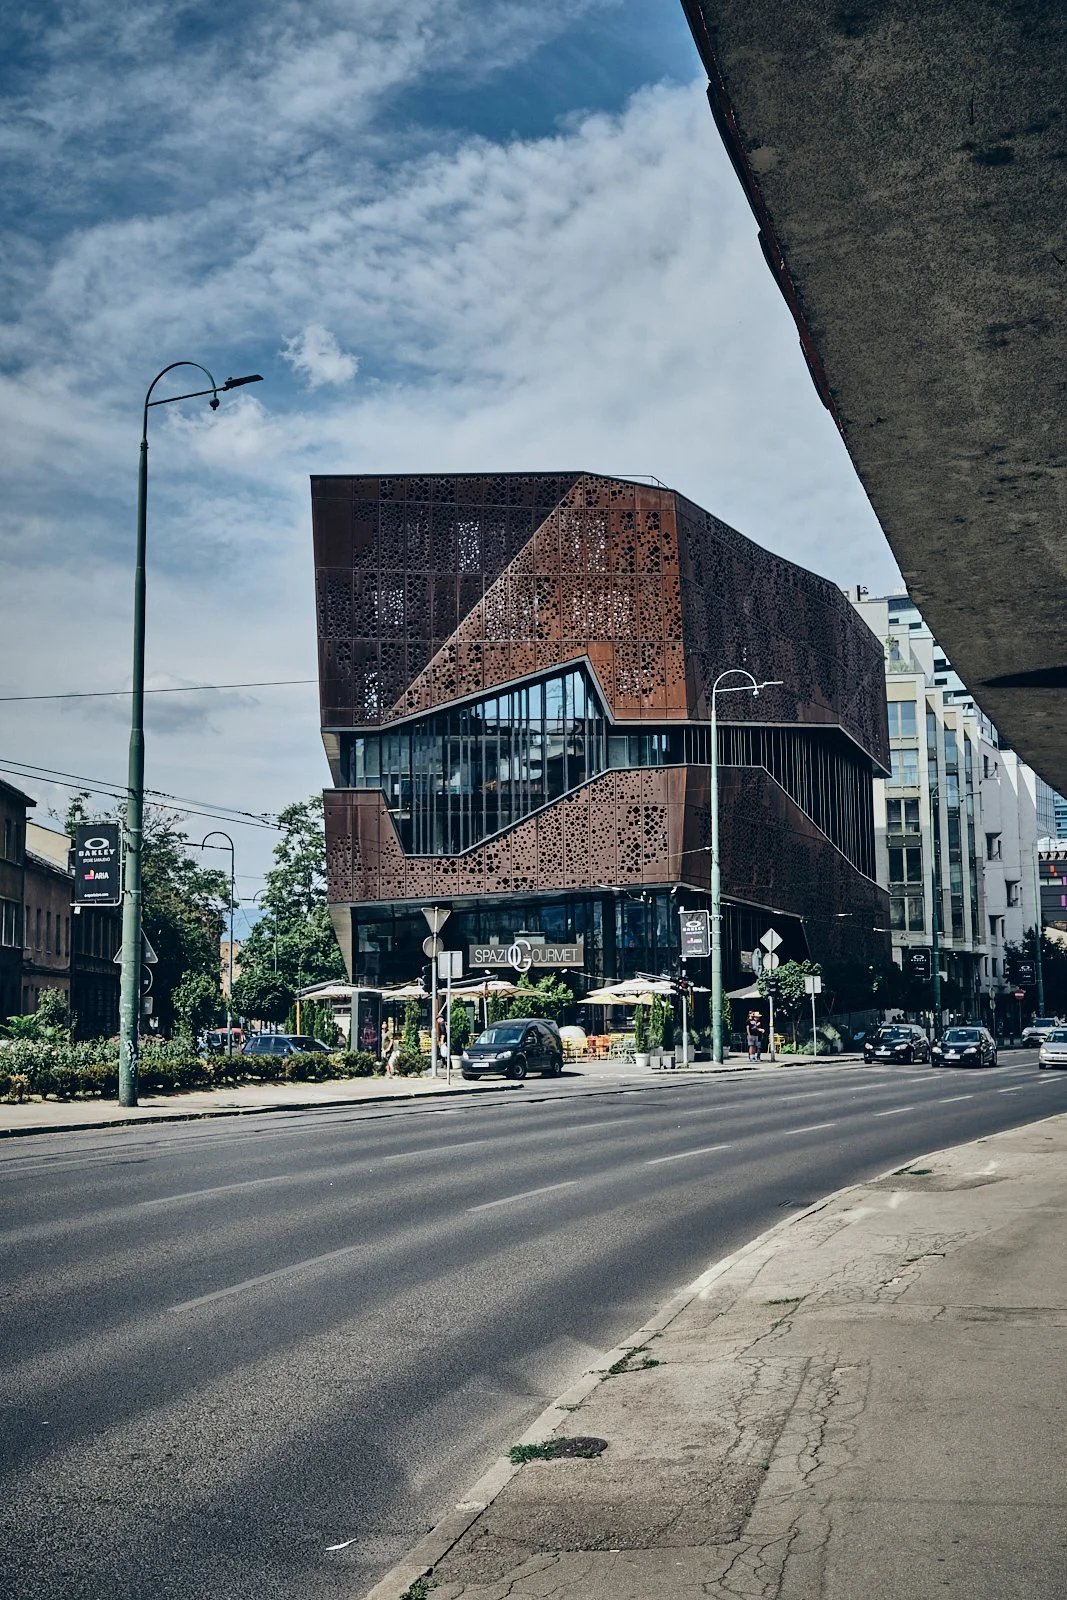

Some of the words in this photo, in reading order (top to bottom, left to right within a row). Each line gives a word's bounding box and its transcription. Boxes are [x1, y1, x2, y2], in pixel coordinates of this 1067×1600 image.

[78, 848, 116, 857] OAKLEY
[94, 871, 110, 880] ARIA
[474, 944, 521, 966] SPAZIO
